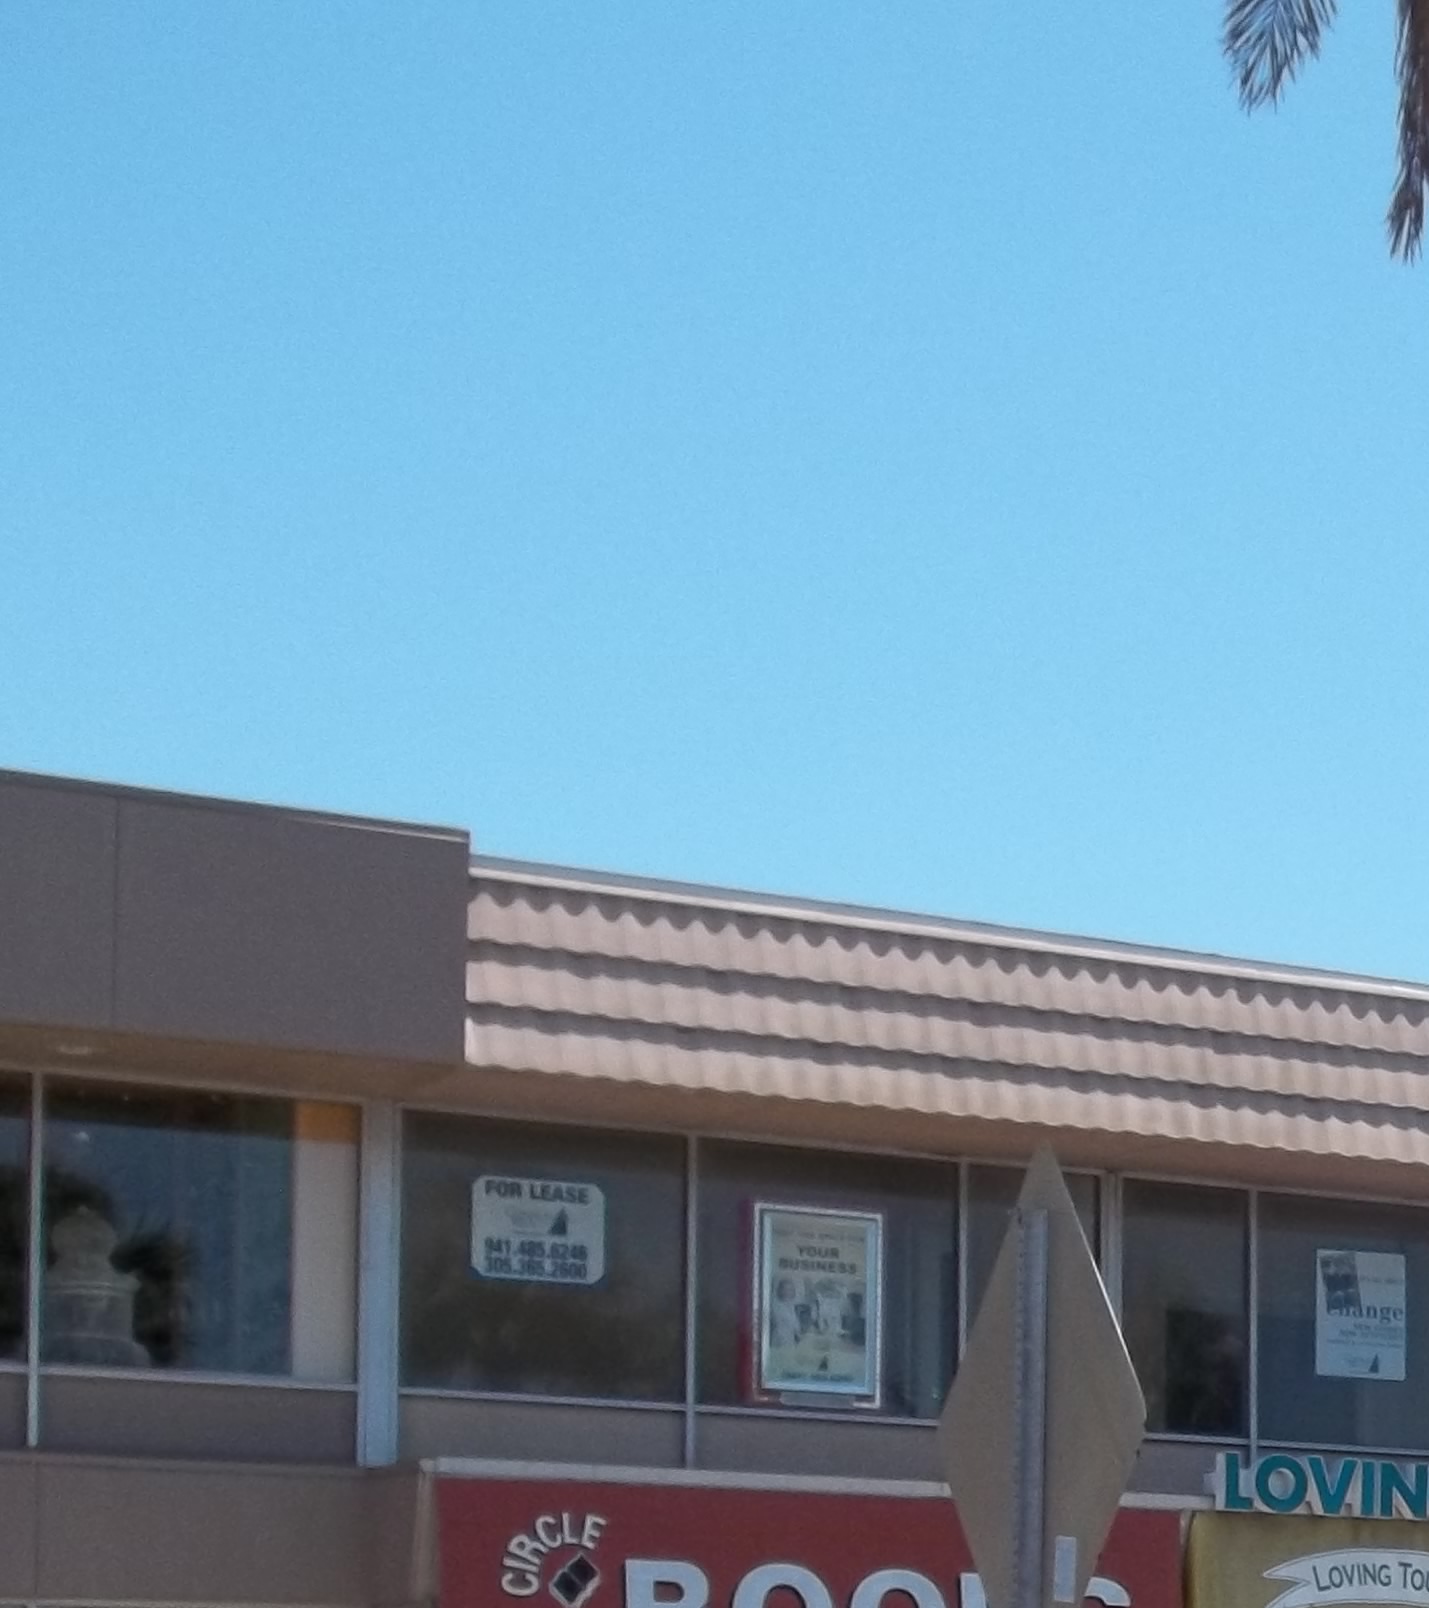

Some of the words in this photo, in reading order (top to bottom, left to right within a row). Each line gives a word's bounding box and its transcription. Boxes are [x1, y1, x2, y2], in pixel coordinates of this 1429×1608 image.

[485, 1179, 522, 1199] FOR
[529, 1181, 590, 1205] LEASE
[797, 1245, 841, 1259] YOUR
[778, 1257, 858, 1275] BUSINESS
[500, 1511, 608, 1599] CIRCLE
[1311, 1562, 1393, 1595] LOVING
